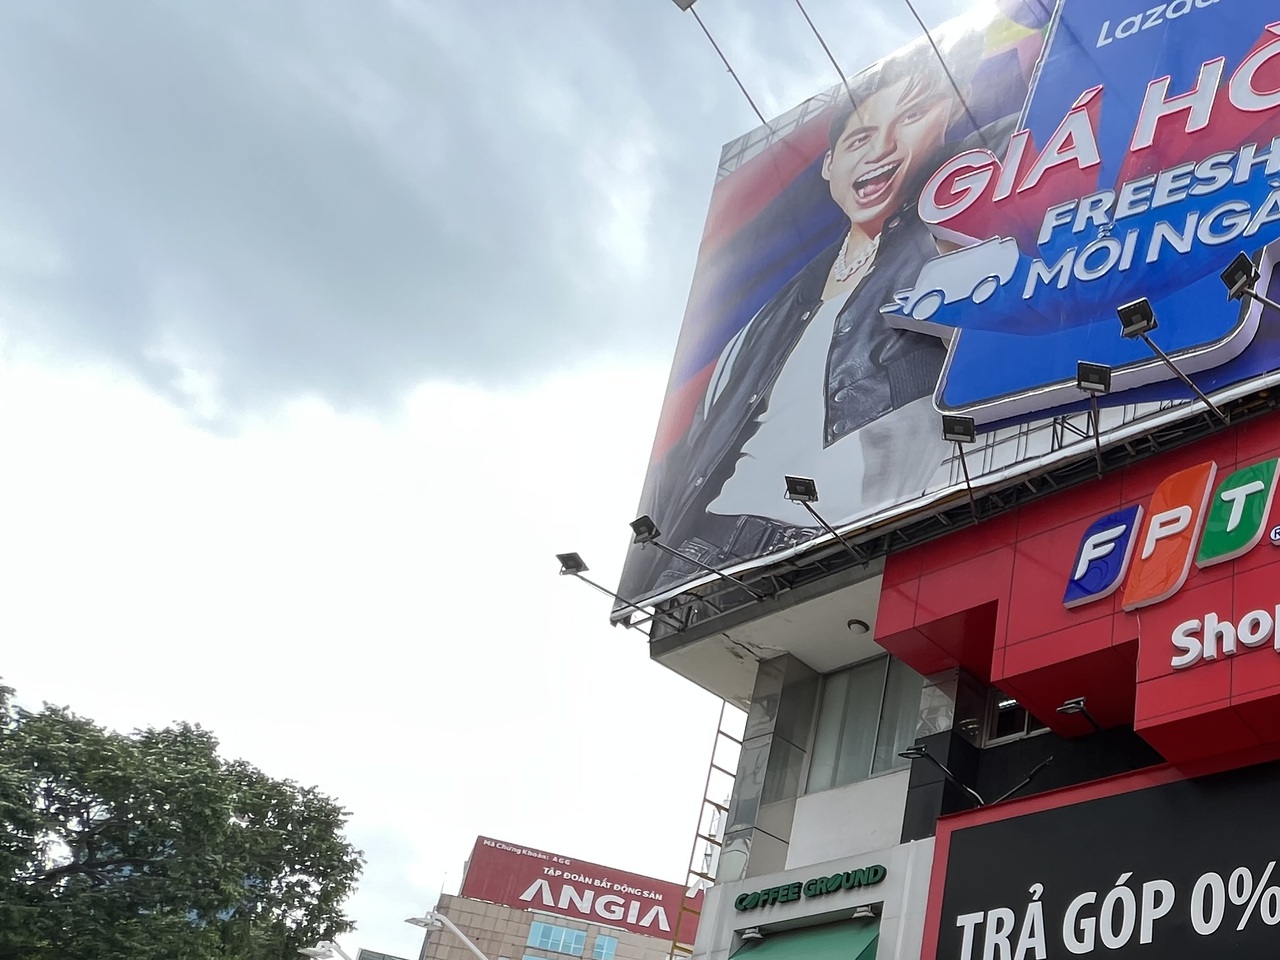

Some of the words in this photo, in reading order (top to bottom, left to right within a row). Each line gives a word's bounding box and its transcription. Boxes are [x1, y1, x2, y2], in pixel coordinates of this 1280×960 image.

[1096, 0, 1220, 48] Laza
[918, 85, 1104, 224] GIÁ
[1023, 222, 1139, 300] MỖI
[1072, 480, 1266, 582] FPT
[552, 856, 571, 866] AGG
[563, 872, 593, 885] ĐOÀN
[613, 882, 643, 897] ĐỘNG
[734, 882, 802, 912] COFFEE
[803, 864, 888, 899] GROUND
[518, 878, 671, 932] ANGIA
[1062, 871, 1176, 955] GÓP
